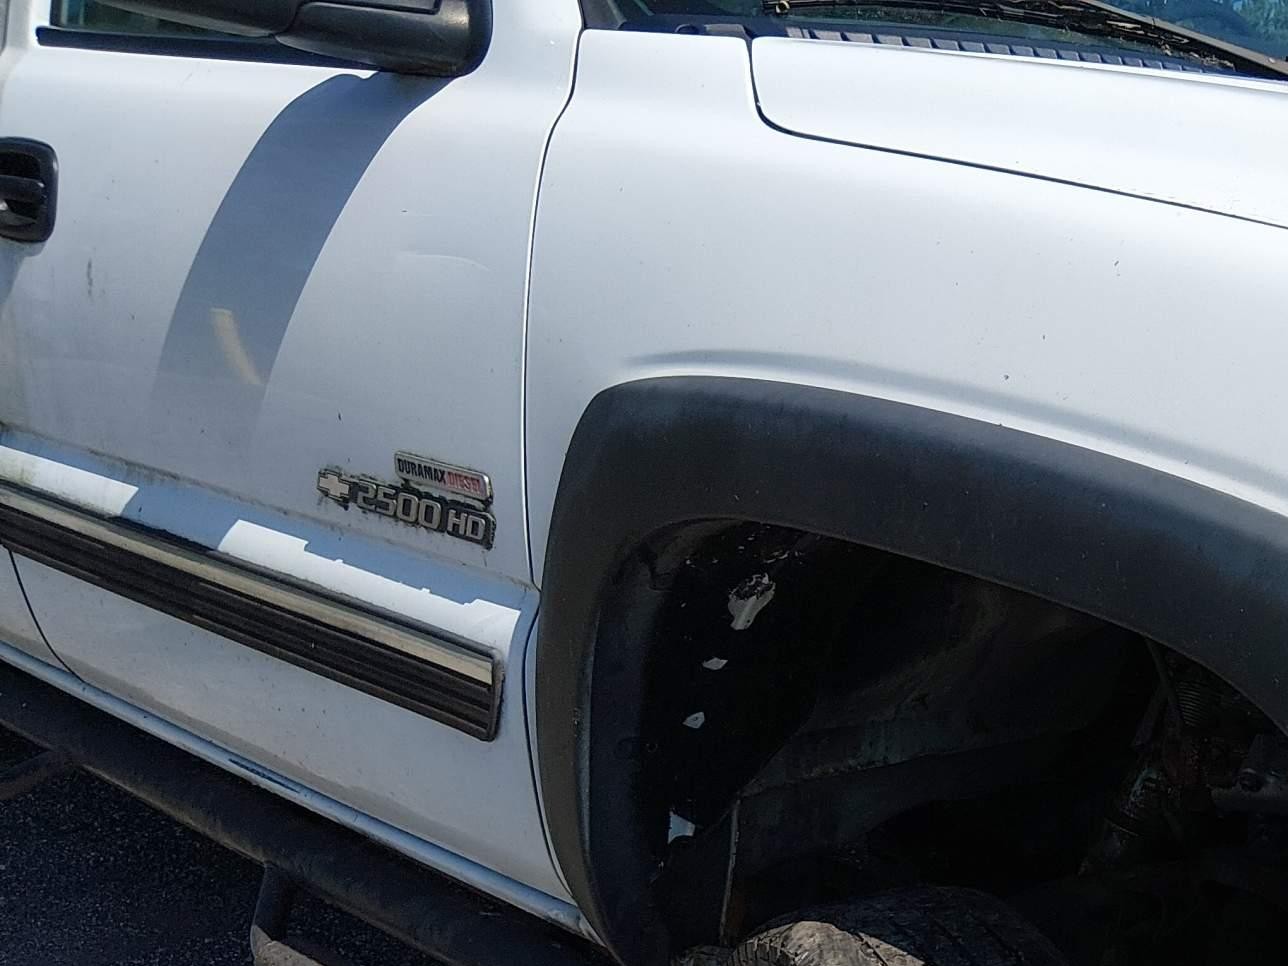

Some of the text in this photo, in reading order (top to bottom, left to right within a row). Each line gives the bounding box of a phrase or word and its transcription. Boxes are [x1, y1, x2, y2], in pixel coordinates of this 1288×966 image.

[397, 458, 482, 493] DURAMAX DIESEL
[357, 482, 486, 540] 2500 HD
